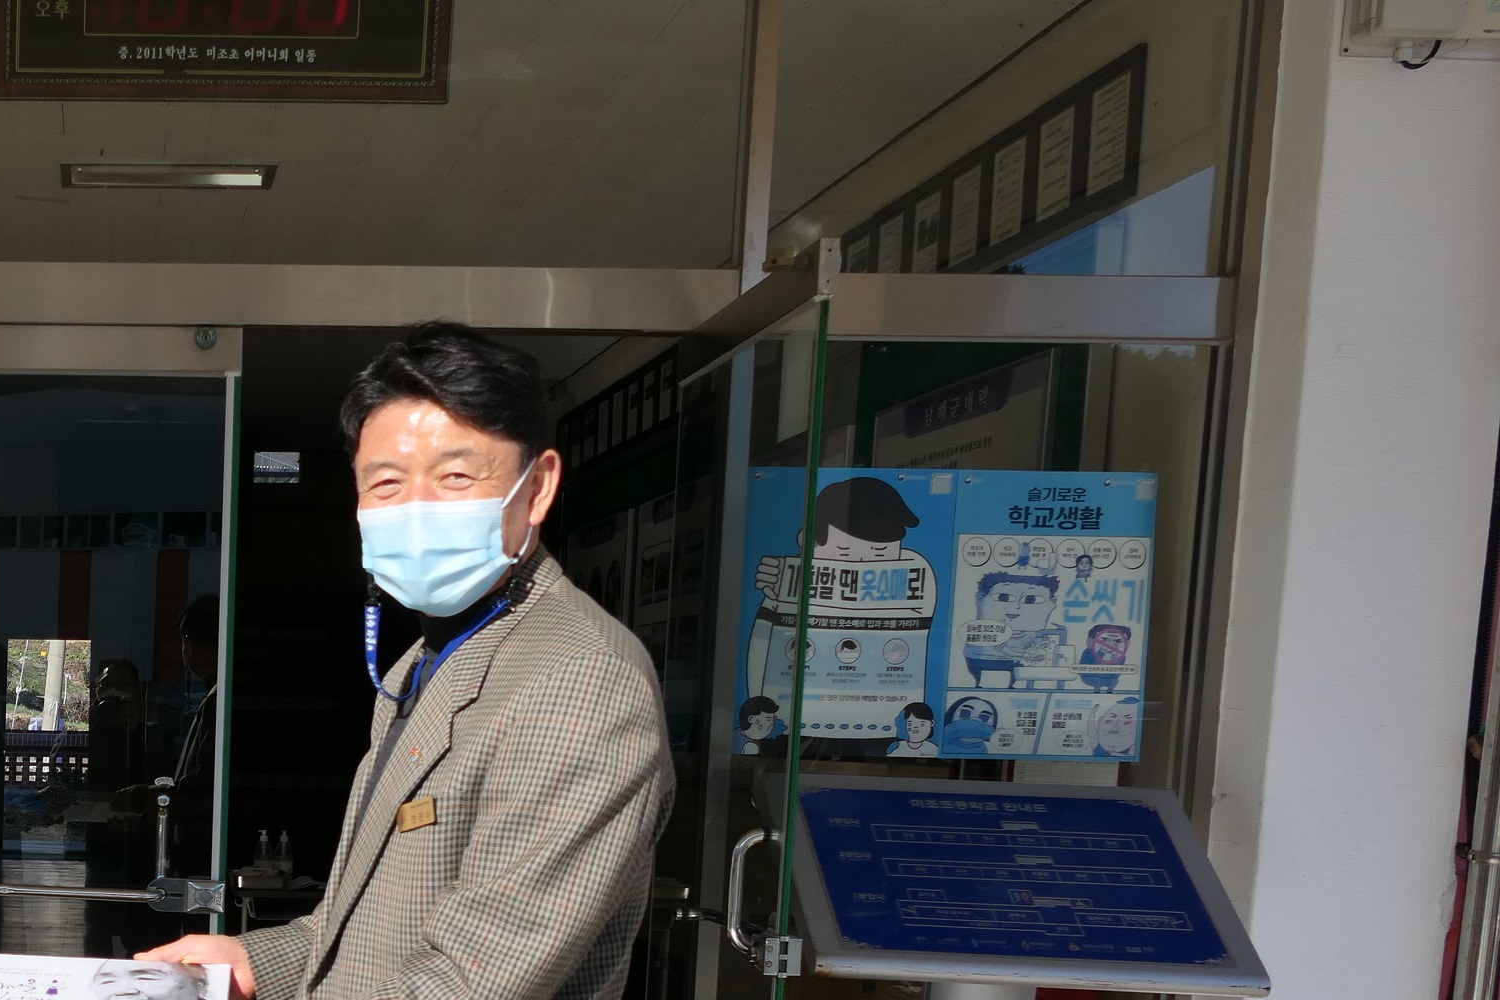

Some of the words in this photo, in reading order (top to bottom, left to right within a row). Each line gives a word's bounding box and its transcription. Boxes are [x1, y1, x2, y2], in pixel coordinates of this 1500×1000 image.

[34, 0, 70, 20] 오후
[136, 45, 199, 60] 2011학년도
[206, 47, 240, 61] 미조초
[244, 48, 289, 62] 어머니회
[294, 49, 317, 63] 일동
[1027, 487, 1087, 502] 슬기로운
[1008, 505, 1104, 530] 학교생활
[839, 567, 859, 602] 땐
[1062, 578, 1145, 625] 손씻기
[898, 619, 920, 628] 가리기
[910, 798, 998, 812] 미조초등학교
[1002, 802, 1048, 813] 안내도
